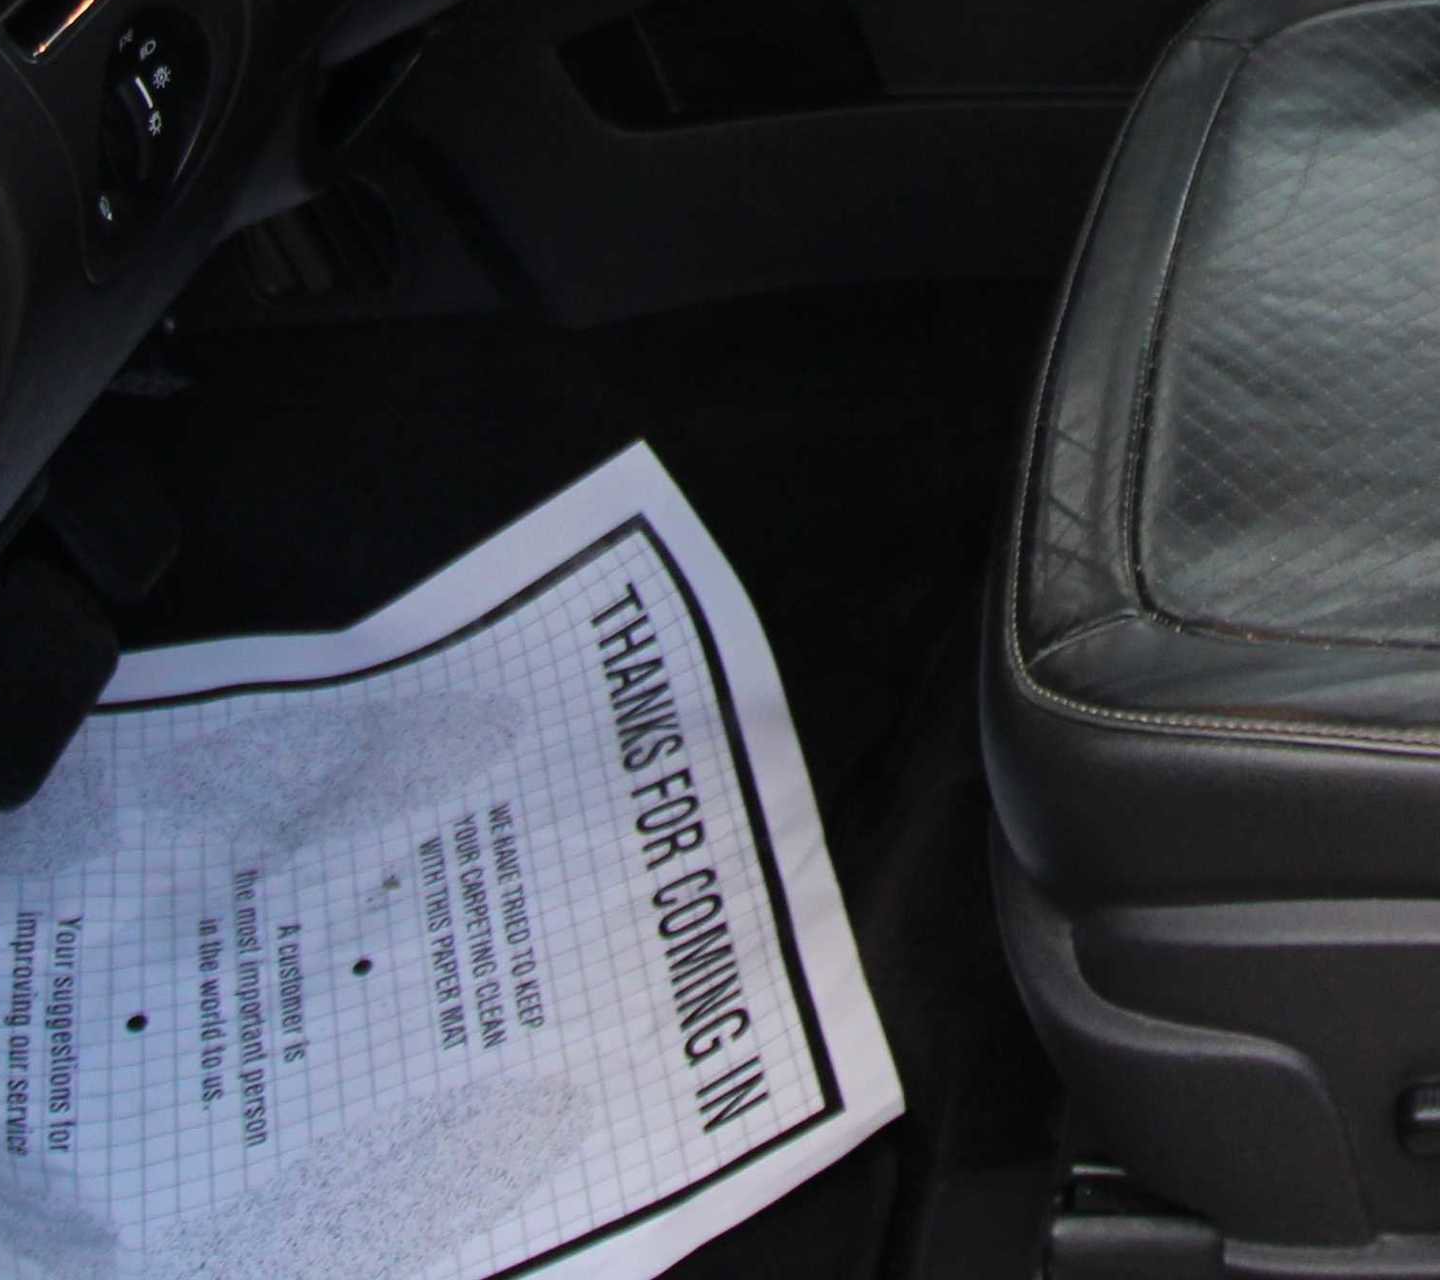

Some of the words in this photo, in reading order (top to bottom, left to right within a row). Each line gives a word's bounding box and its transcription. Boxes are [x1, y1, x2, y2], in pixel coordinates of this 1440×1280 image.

[589, 581, 684, 774] THANKS
[453, 812, 481, 865] YOUR
[488, 801, 513, 834] WE
[629, 766, 707, 872] FOR
[235, 868, 259, 902] the
[418, 835, 446, 886] WITH
[491, 835, 521, 886] HAVE
[198, 917, 223, 937] in
[235, 906, 263, 956] most
[276, 922, 302, 941] A
[425, 886, 453, 933] THIS
[459, 866, 497, 979] CARPETING
[501, 885, 531, 945] TRIED
[54, 913, 85, 970] Your
[198, 941, 223, 974] the
[511, 946, 538, 978] TO
[3, 910, 43, 1028] improving
[277, 942, 306, 1037] customer
[430, 934, 462, 1004] PAPER
[651, 867, 751, 1070] COMING
[199, 978, 227, 1043] world
[233, 958, 268, 1066] important
[439, 1004, 469, 1052] MAT
[474, 980, 507, 1051] CLEAN
[514, 978, 546, 1030] KEEP
[7, 1032, 31, 1074] our
[45, 974, 80, 1115] suggestions
[201, 1045, 227, 1072] to
[283, 1038, 310, 1065] is
[5, 1077, 34, 1158] service
[201, 1074, 224, 1113] us.
[238, 1068, 269, 1149] person
[694, 1054, 769, 1135] IN
[48, 1120, 77, 1154] for
